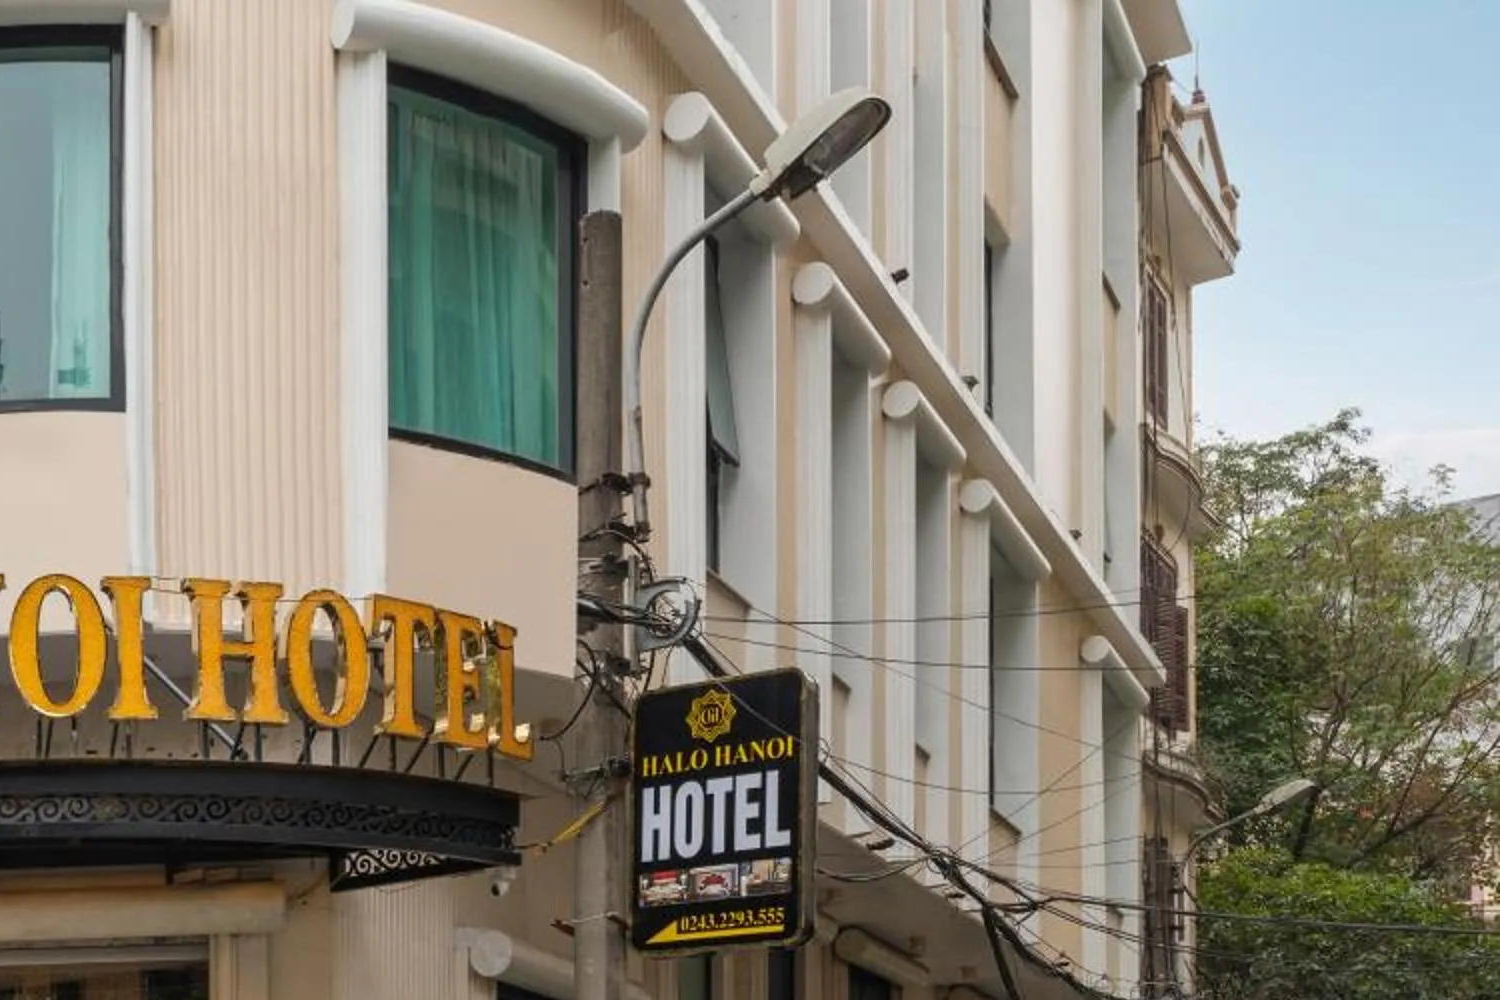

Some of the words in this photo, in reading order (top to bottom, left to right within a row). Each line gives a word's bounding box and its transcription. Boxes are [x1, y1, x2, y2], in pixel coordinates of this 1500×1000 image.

[181, 576, 535, 762] HOTEL
[643, 750, 708, 777] HALO
[715, 735, 794, 767] HANOI
[640, 769, 791, 863] HOTEL
